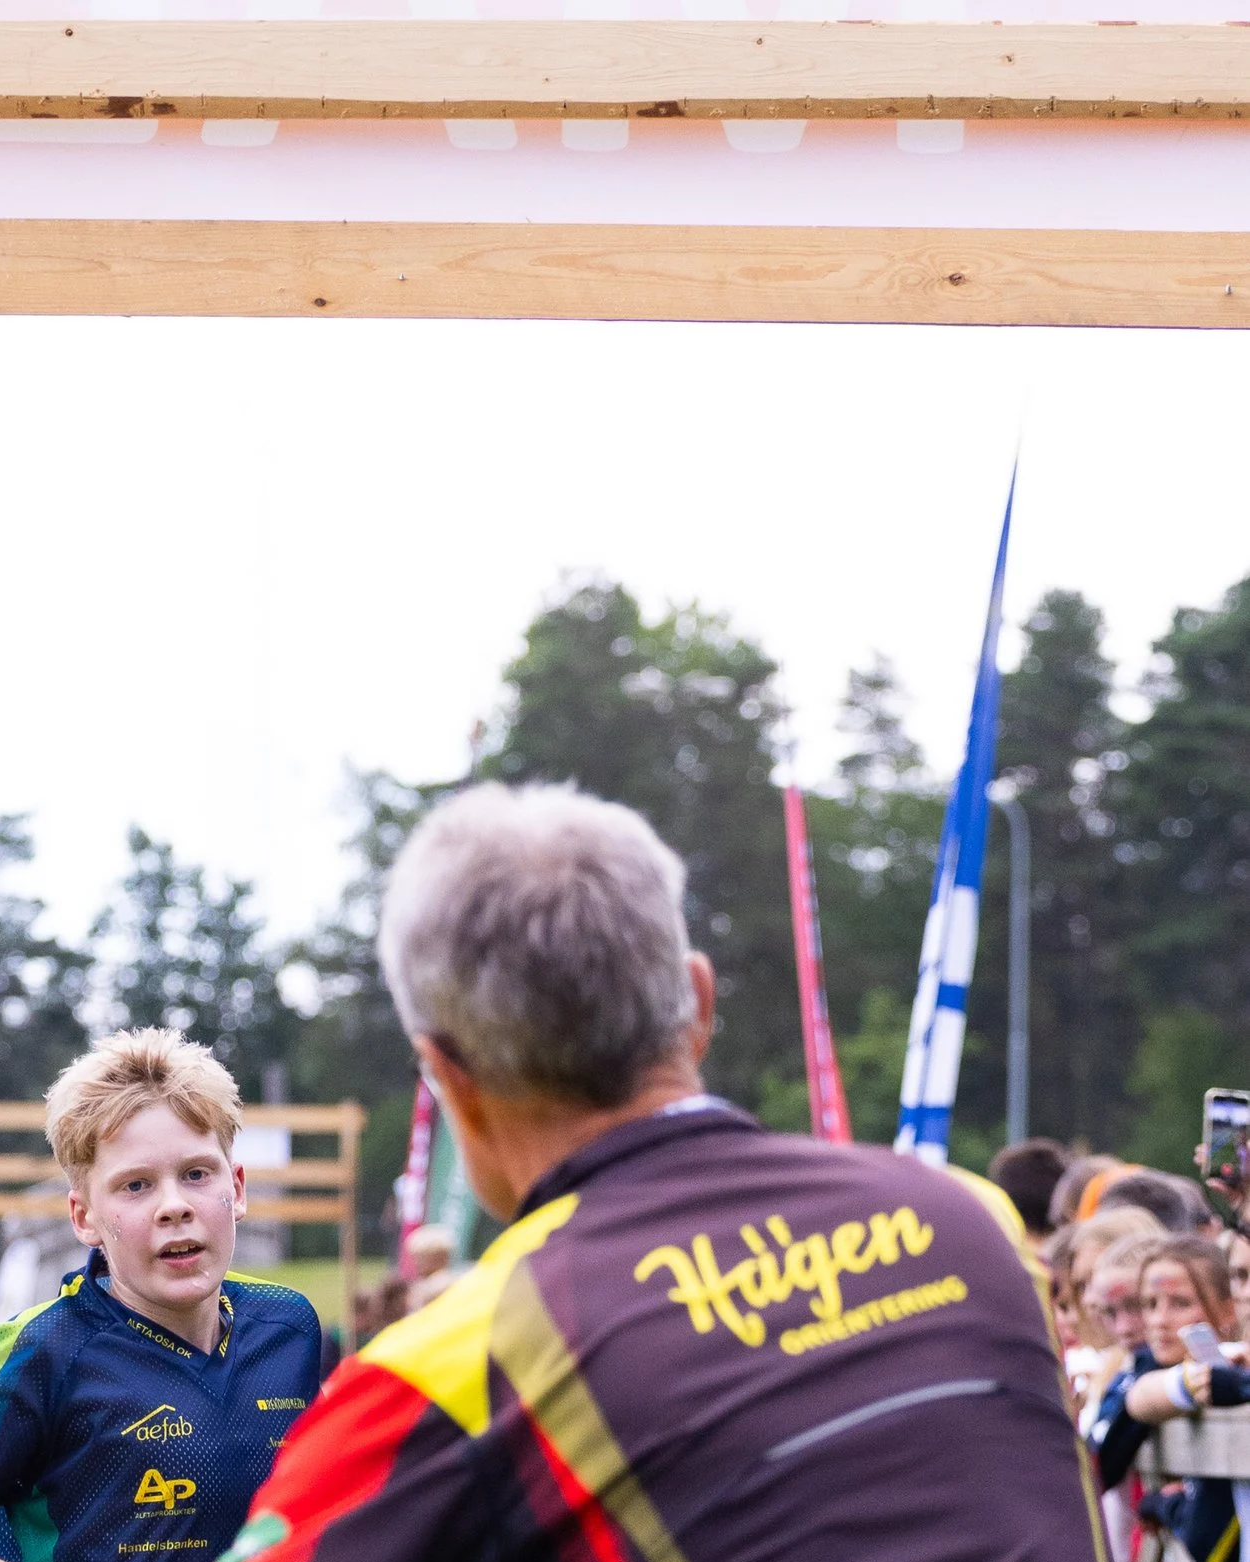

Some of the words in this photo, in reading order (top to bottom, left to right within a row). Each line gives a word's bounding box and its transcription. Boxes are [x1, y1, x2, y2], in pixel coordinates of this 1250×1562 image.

[176, 1347, 192, 1359] OK
[136, 1415, 193, 1444] aefab
[134, 1469, 197, 1510] AP
[118, 1538, 208, 1554] Handelsbanken
